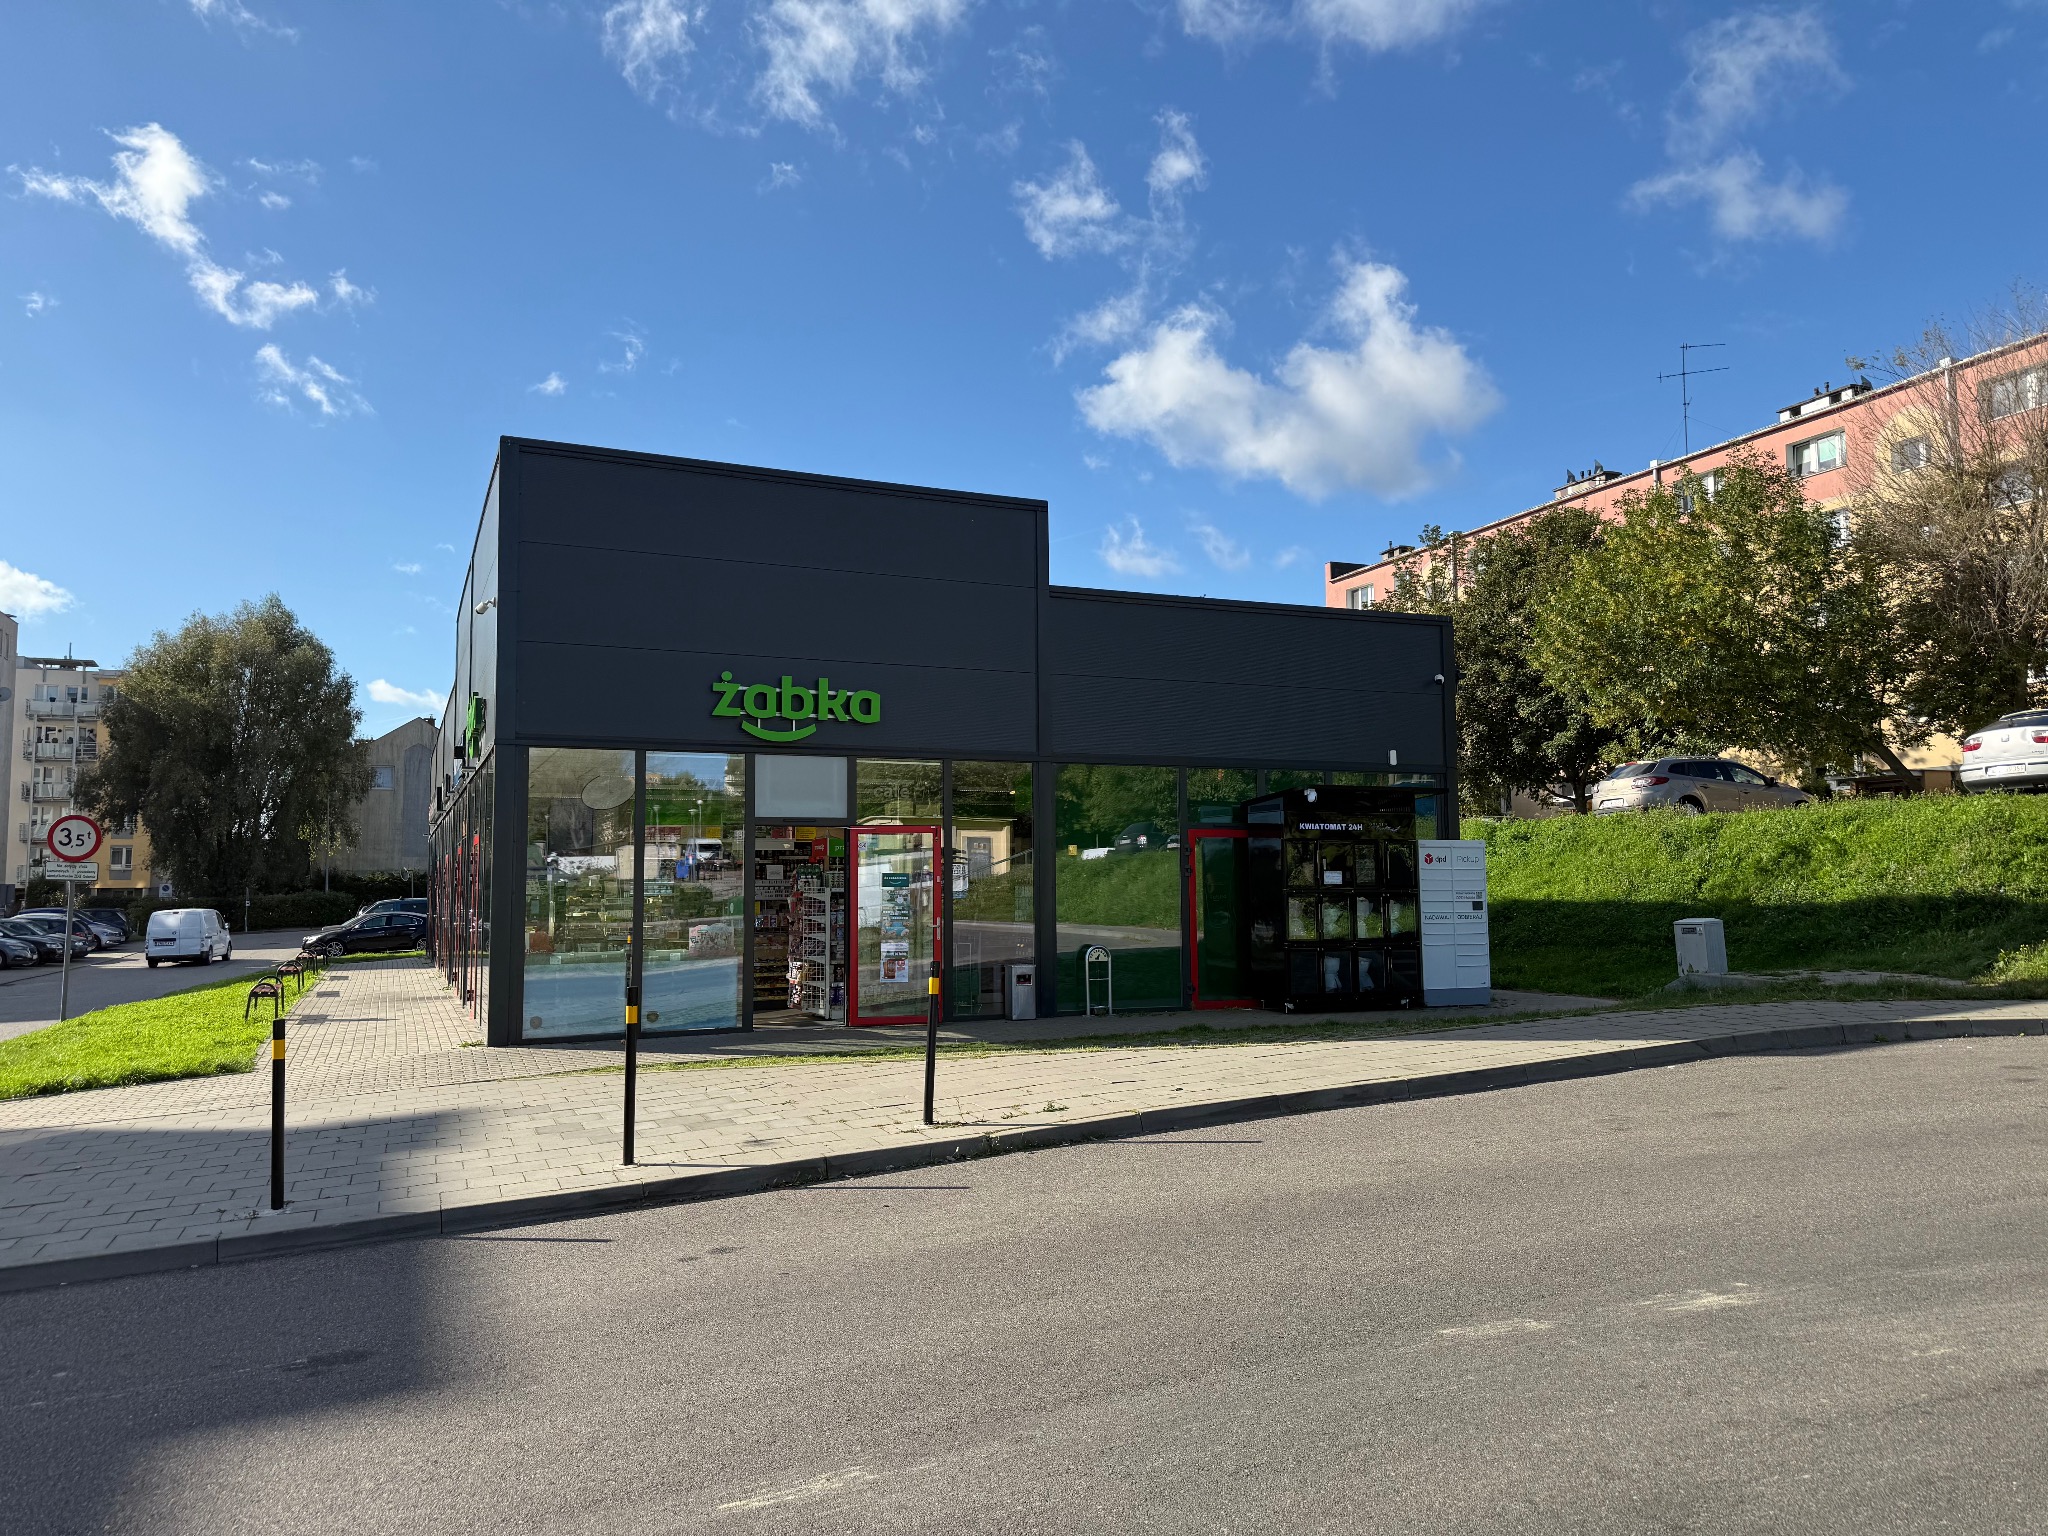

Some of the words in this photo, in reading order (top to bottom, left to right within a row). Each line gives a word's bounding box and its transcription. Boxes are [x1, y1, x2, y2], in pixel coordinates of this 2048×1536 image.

[712, 671, 881, 724] żabka
[1299, 822, 1347, 831] KWIATOMAT
[1348, 823, 1363, 831] 24H
[1434, 855, 1447, 864] dpd
[1456, 855, 1480, 864] Pickup
